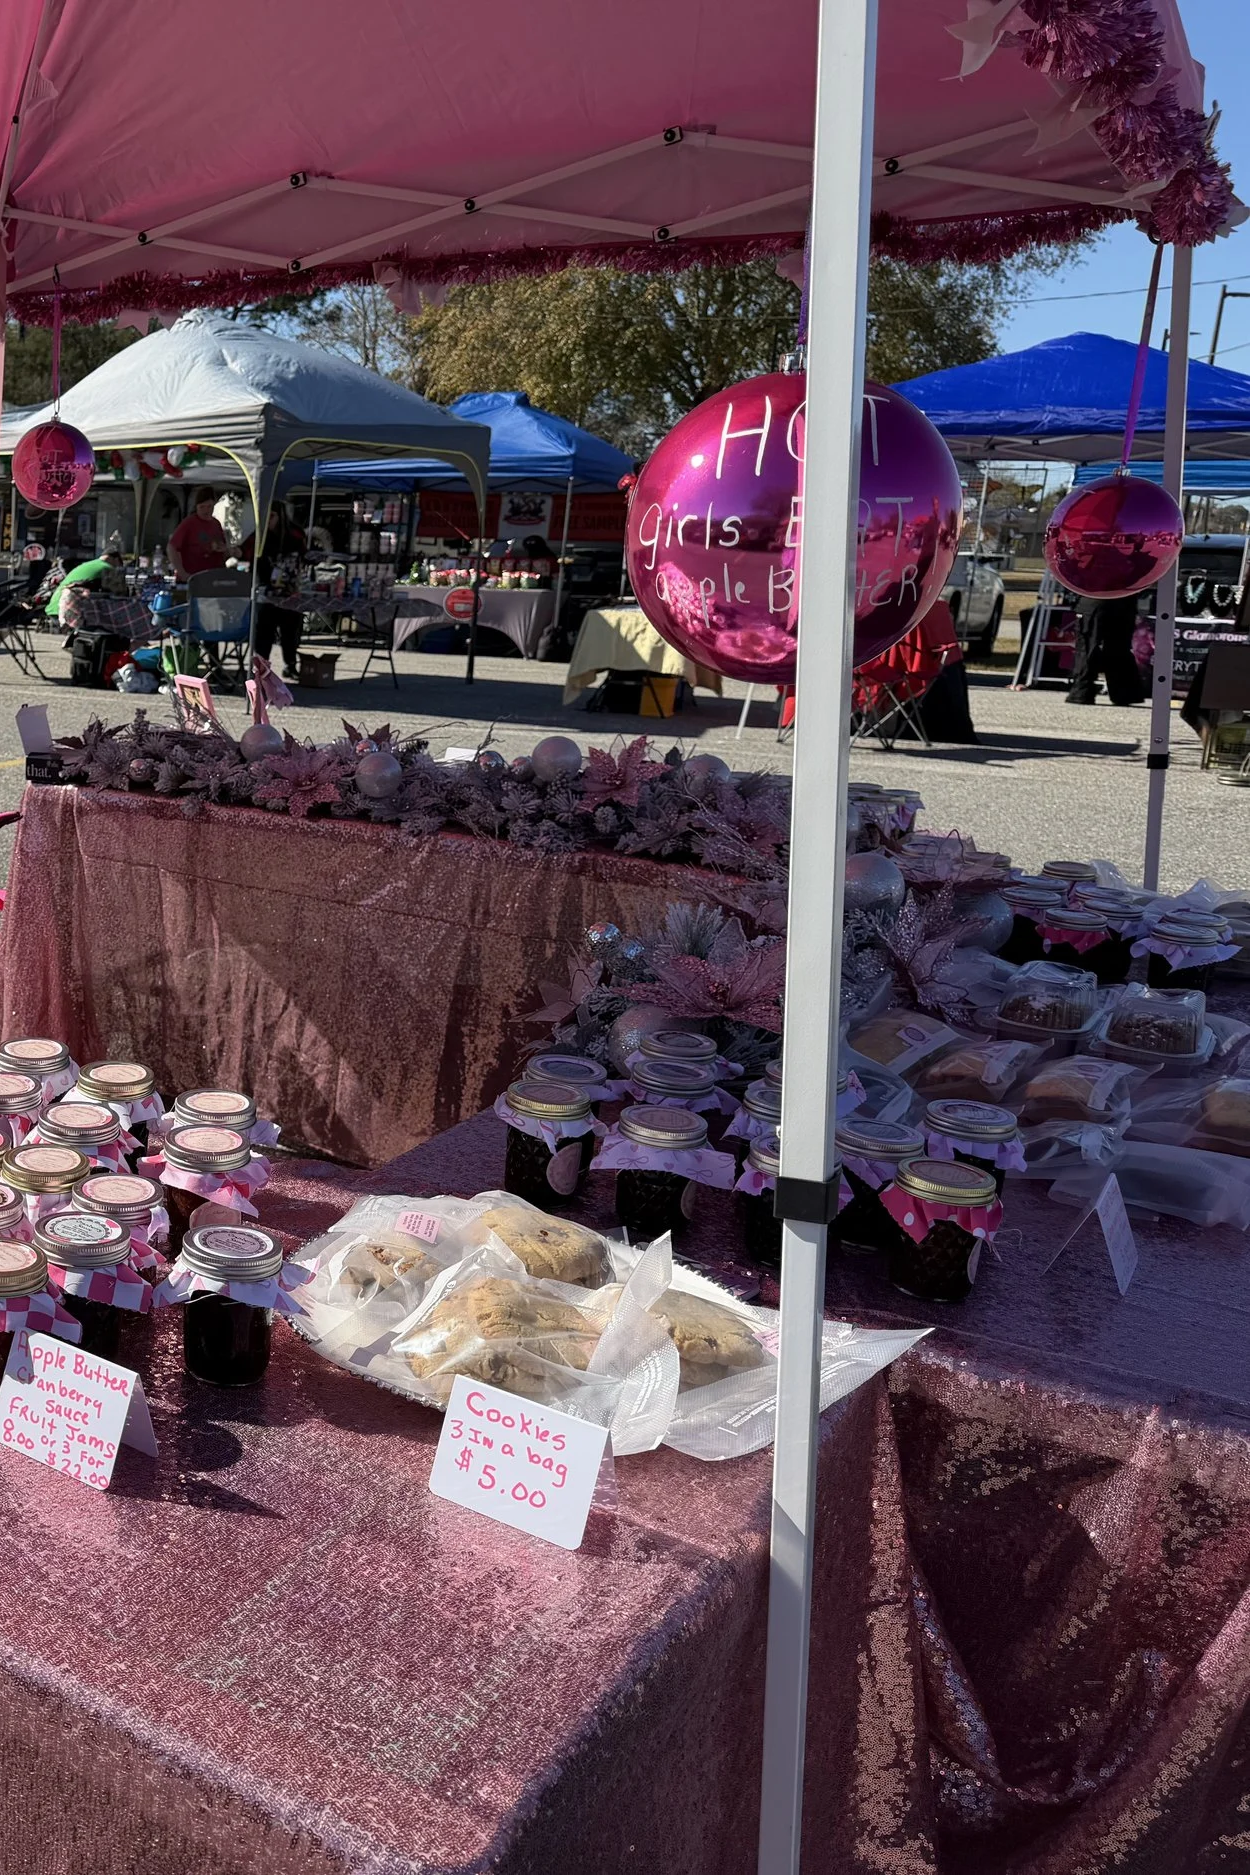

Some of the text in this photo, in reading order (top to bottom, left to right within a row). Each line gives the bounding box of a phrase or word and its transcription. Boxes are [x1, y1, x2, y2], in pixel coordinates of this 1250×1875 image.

[17, 1330, 67, 1372] Apple
[3, 1418, 35, 1450] 8.00
[62, 1441, 71, 1455] 3
[465, 1391, 567, 1452] Cookies
[449, 1419, 464, 1440] 3
[501, 1442, 515, 1457] a
[526, 1446, 569, 1488] bag
